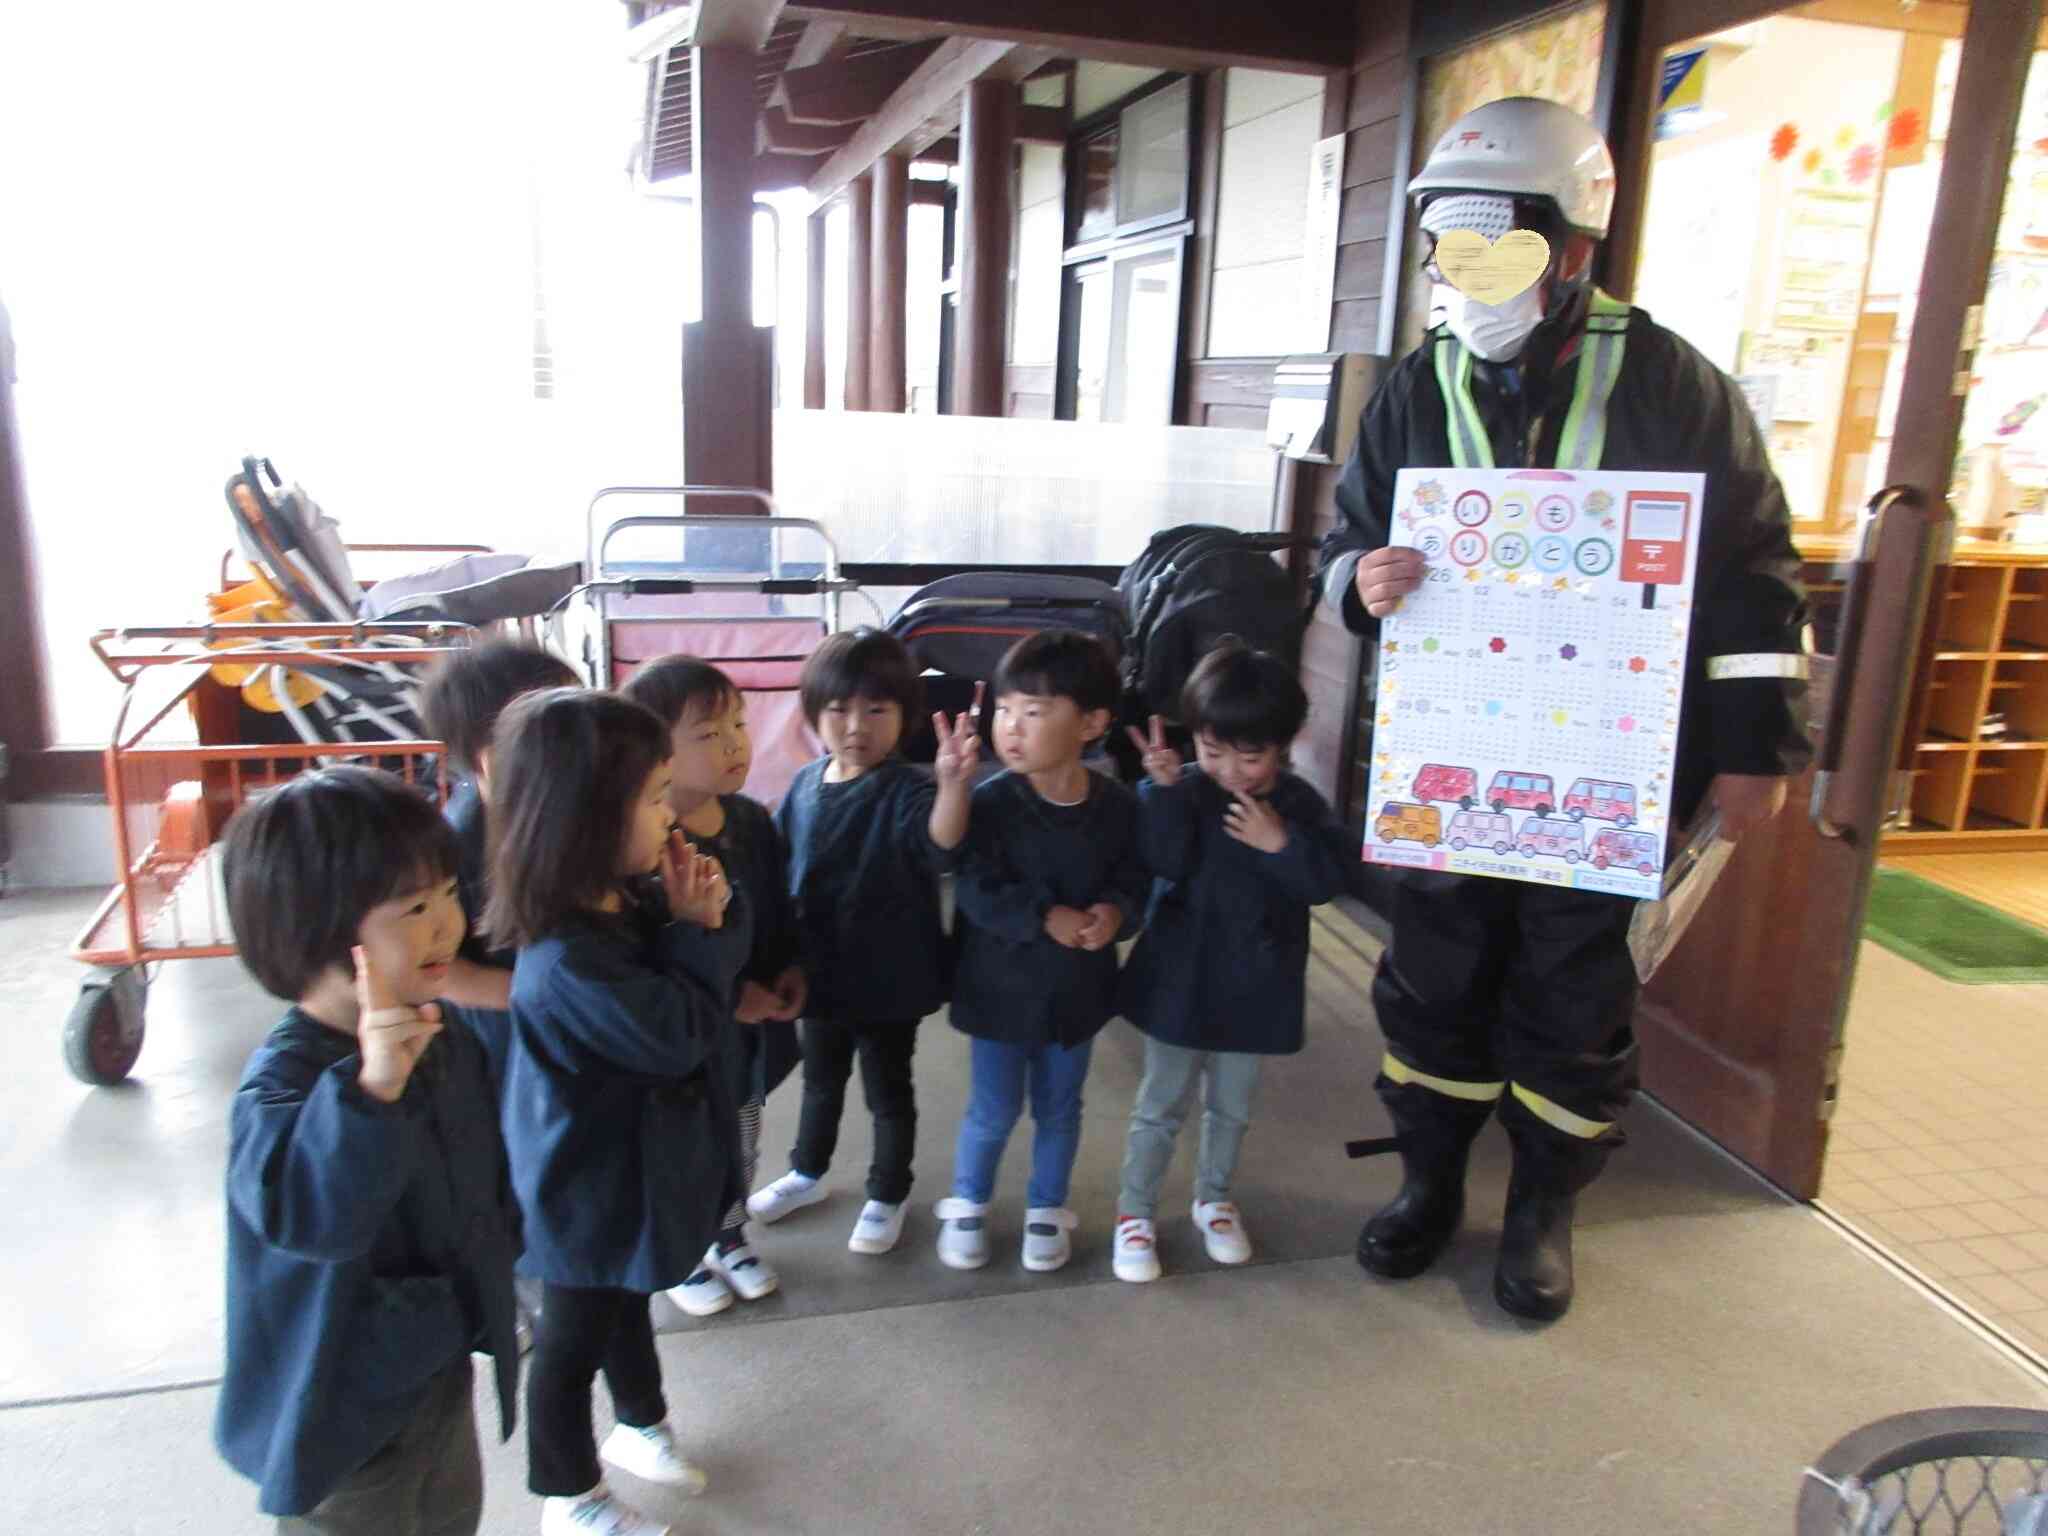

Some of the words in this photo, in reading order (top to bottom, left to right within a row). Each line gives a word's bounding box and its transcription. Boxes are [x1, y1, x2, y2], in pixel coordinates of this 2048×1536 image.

[1459, 496, 1566, 525] いつも
[1423, 534, 1601, 567] ありがとう
